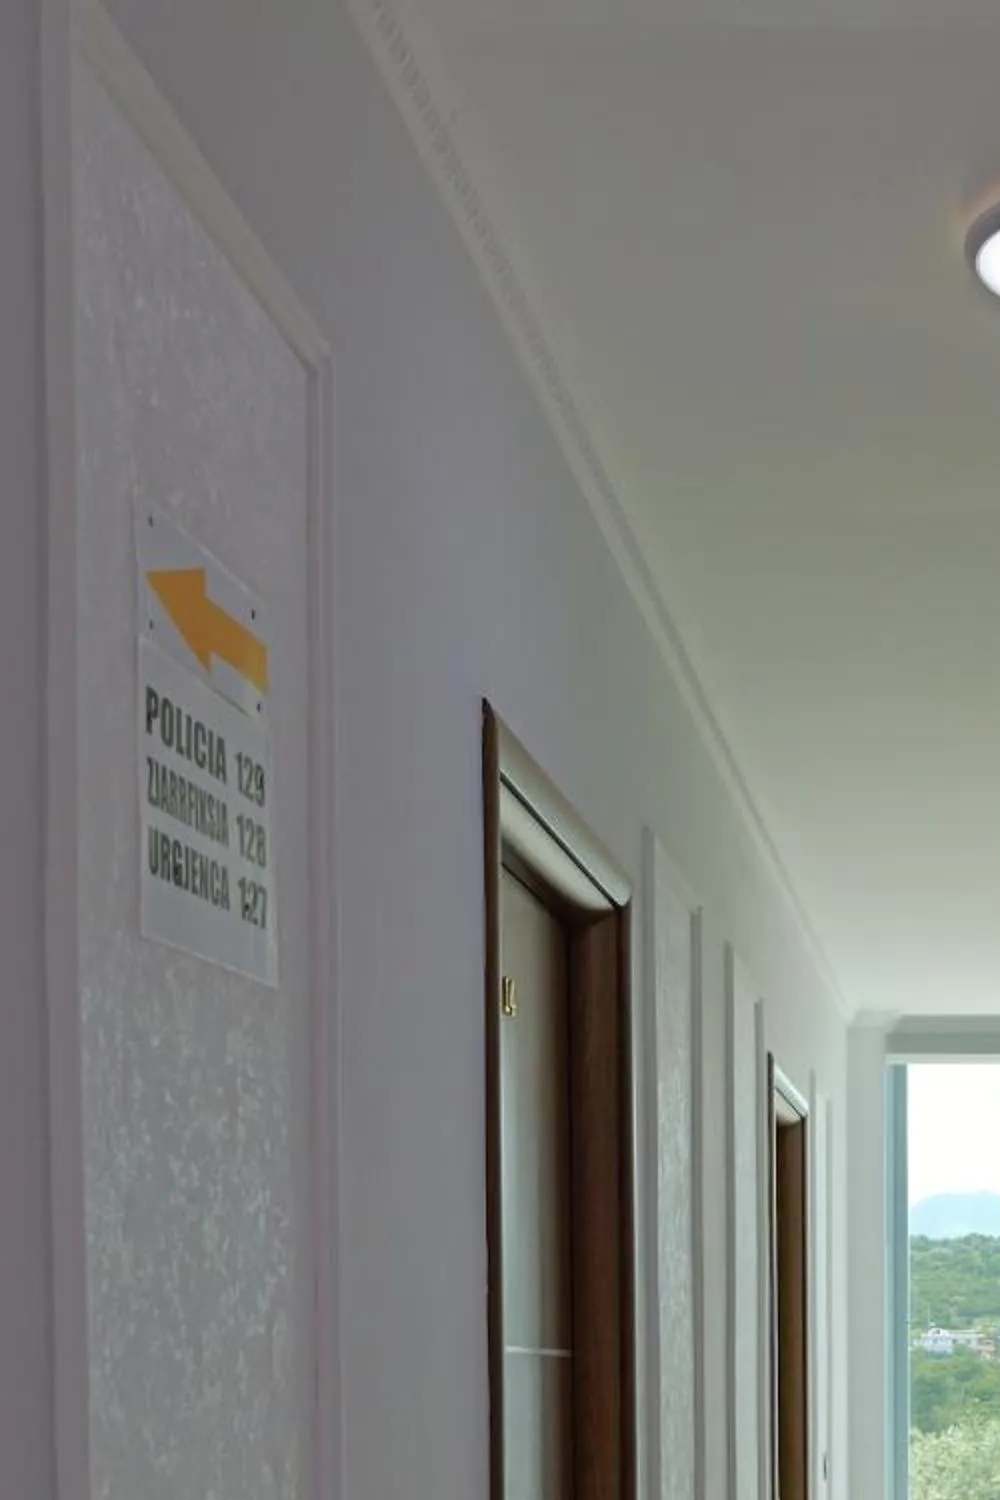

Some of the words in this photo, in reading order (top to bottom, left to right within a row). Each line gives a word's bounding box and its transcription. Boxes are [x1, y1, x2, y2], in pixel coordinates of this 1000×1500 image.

[146, 685, 227, 785] POLICIA
[236, 751, 265, 808] 129
[236, 813, 266, 868] 128
[237, 876, 267, 929] 127
